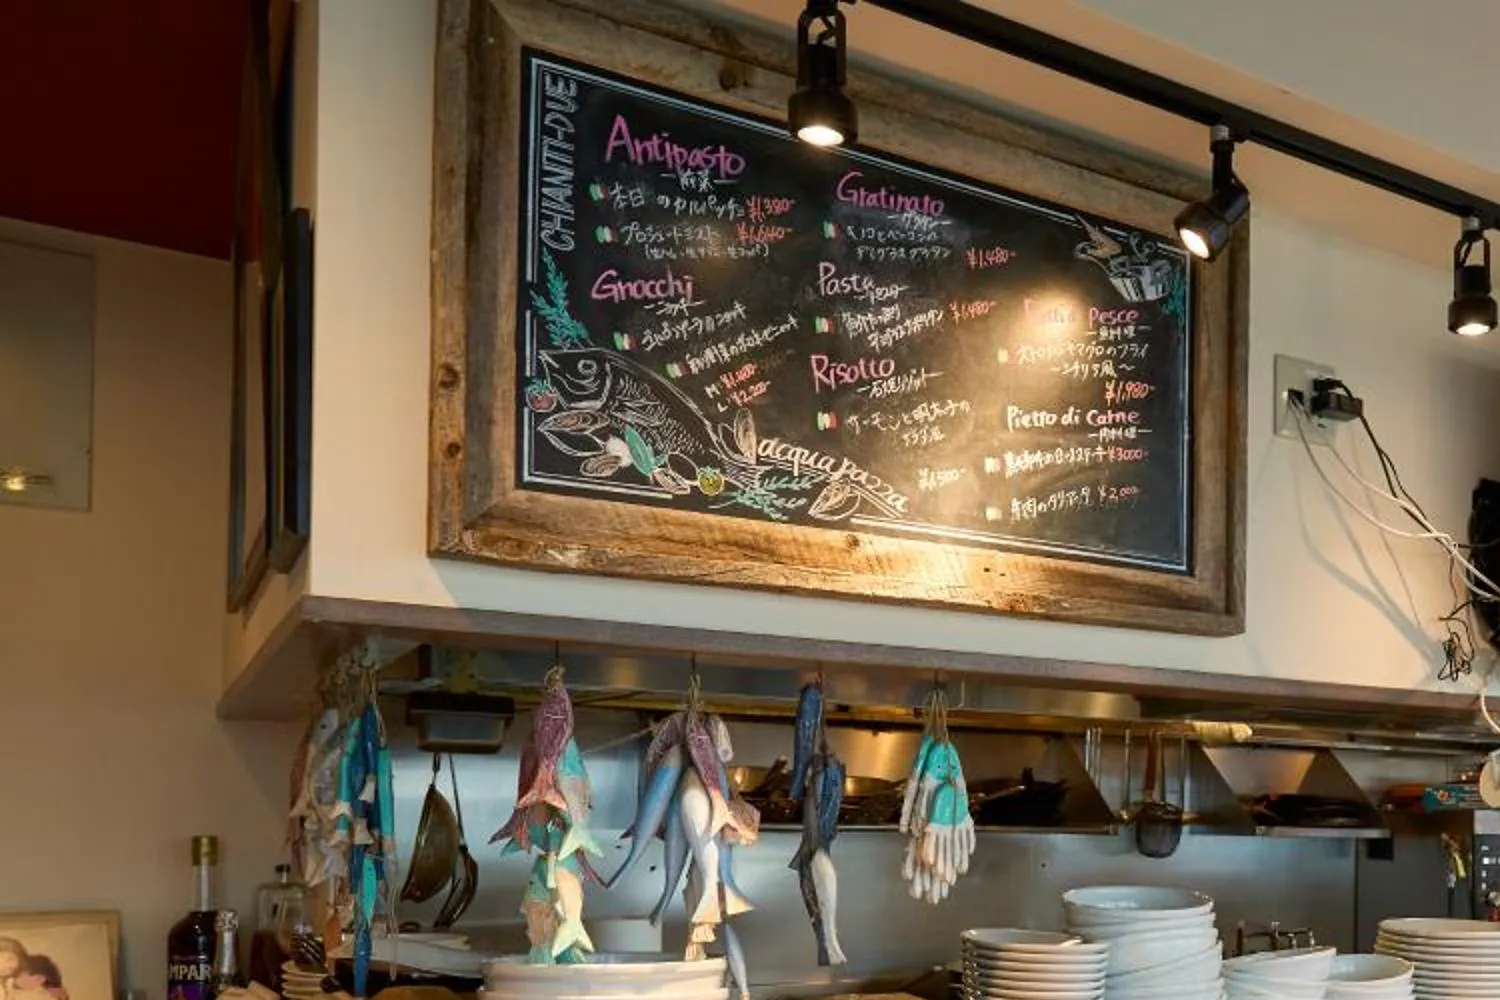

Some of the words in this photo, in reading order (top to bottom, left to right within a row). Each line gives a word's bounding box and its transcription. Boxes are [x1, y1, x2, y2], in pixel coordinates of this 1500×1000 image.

[605, 114, 746, 178] Antipasto
[591, 264, 694, 303] Gnocchi
[817, 261, 876, 297] Pasta
[1089, 306, 1139, 328] Pesce
[810, 353, 895, 393] Risotto
[1062, 406, 1080, 426] di
[1086, 409, 1141, 426] Carne
[169, 963, 214, 981] MPAR
